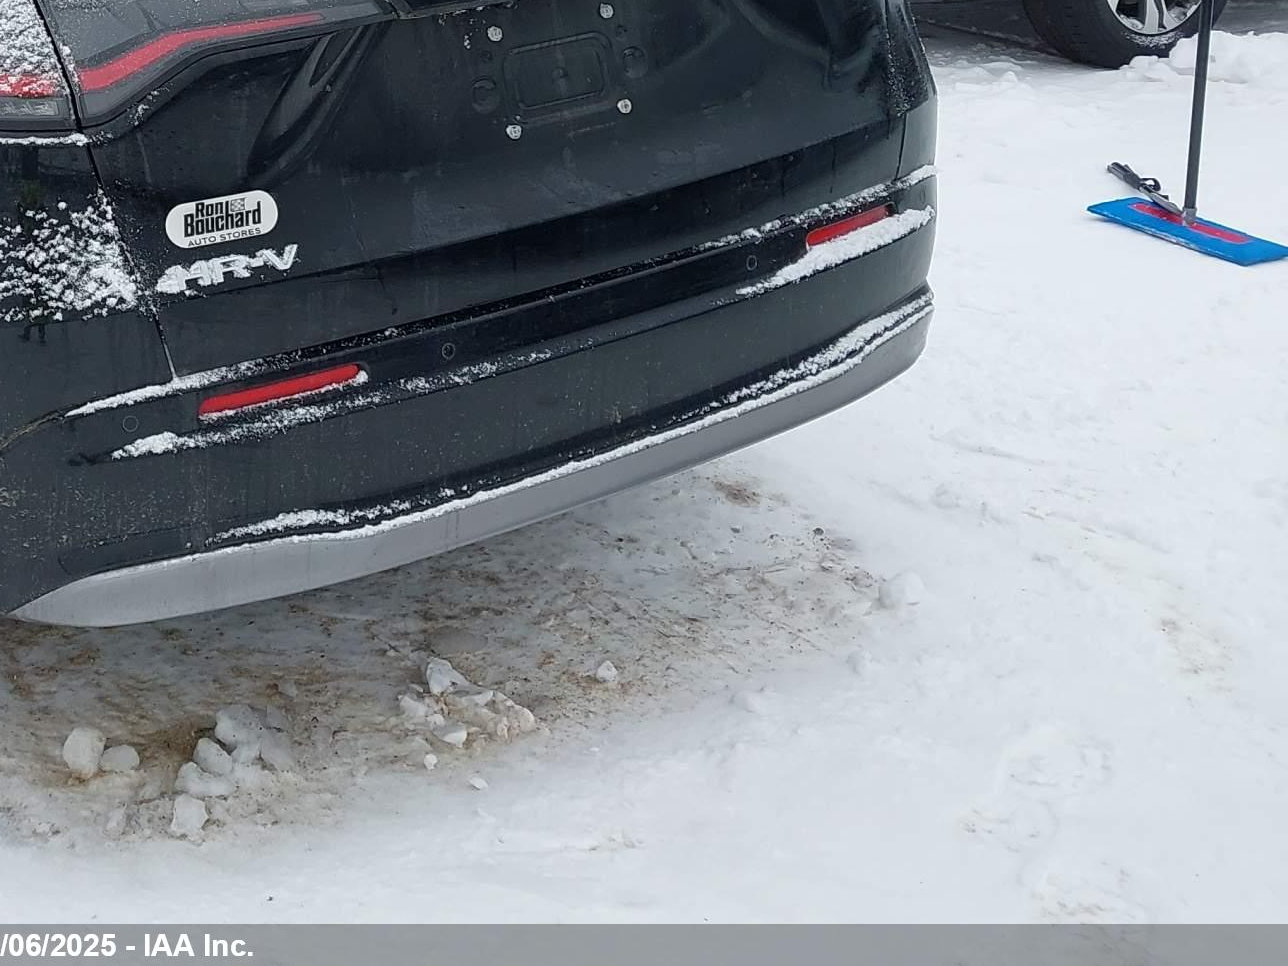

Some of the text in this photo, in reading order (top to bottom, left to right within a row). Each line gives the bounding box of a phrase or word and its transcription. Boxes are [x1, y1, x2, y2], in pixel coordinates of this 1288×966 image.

[184, 200, 262, 238] Bouchard
[195, 201, 224, 219] Ron
[188, 227, 262, 248] AUTO STORES
[155, 244, 299, 294] HR-V
